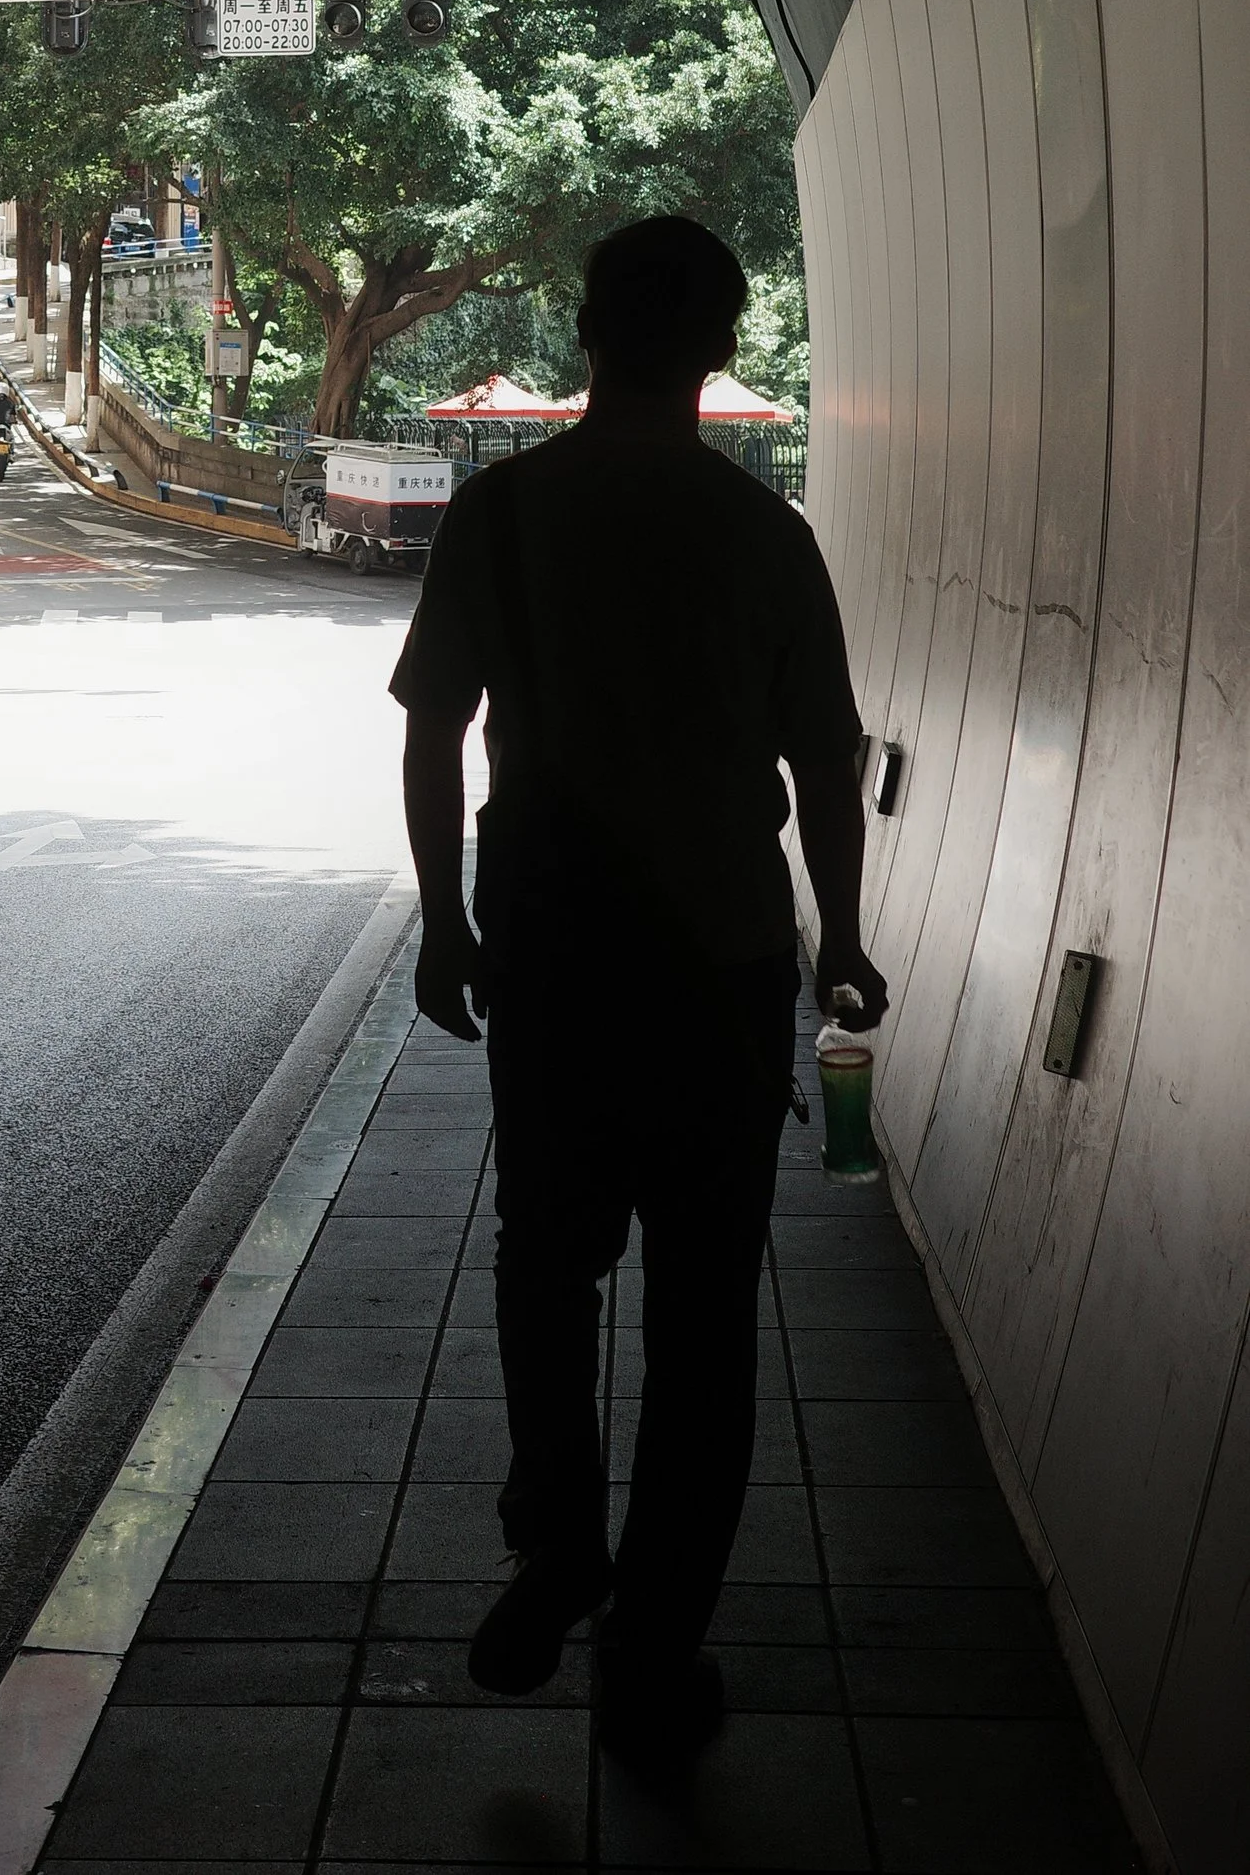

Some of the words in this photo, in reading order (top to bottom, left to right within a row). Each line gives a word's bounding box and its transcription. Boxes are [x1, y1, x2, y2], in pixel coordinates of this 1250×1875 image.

[223, 18, 308, 33] 07:00-07:30
[223, 35, 309, 50] 20:00-22:00
[337, 470, 380, 488] 重庆快递
[398, 477, 445, 490] 重庆快递
